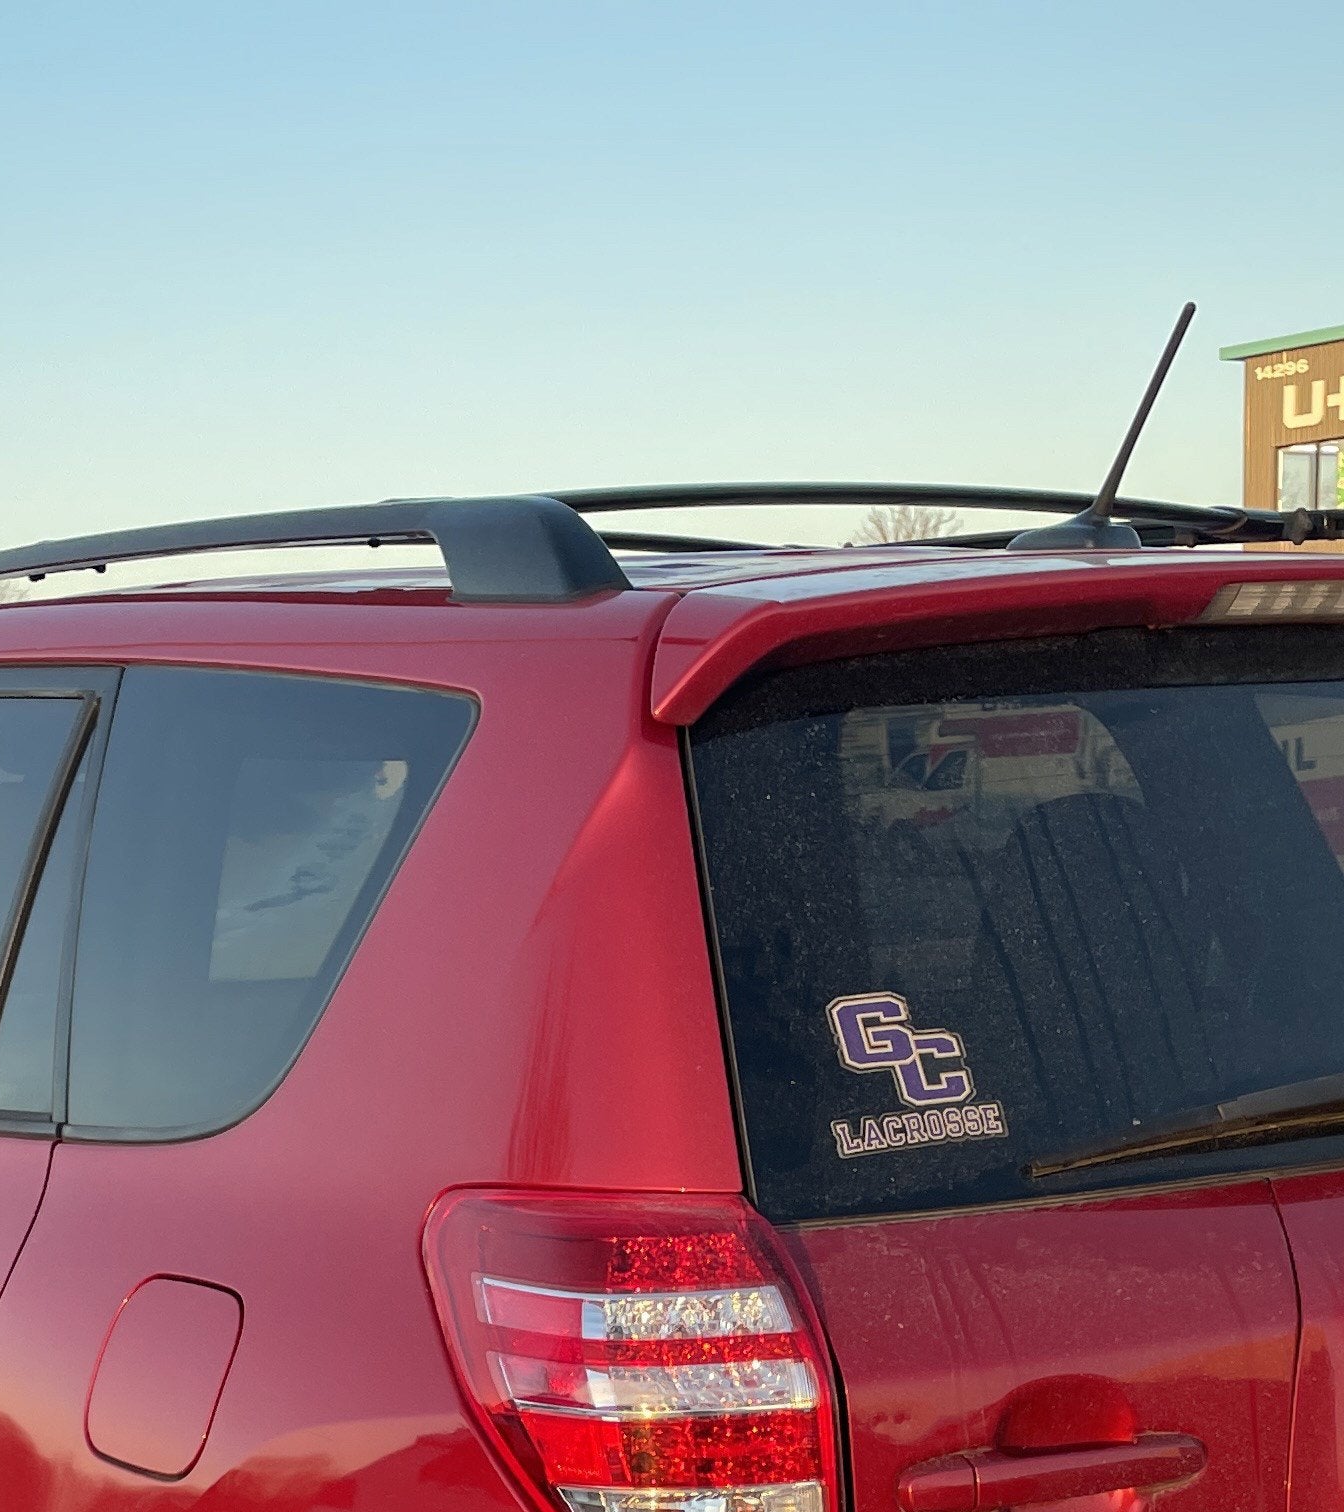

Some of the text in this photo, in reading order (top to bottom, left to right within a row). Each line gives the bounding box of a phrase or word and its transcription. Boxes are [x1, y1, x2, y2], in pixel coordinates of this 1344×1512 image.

[1254, 359, 1309, 380] 14296
[826, 992, 976, 1107] GC
[832, 1102, 1008, 1157] LACROSSE
